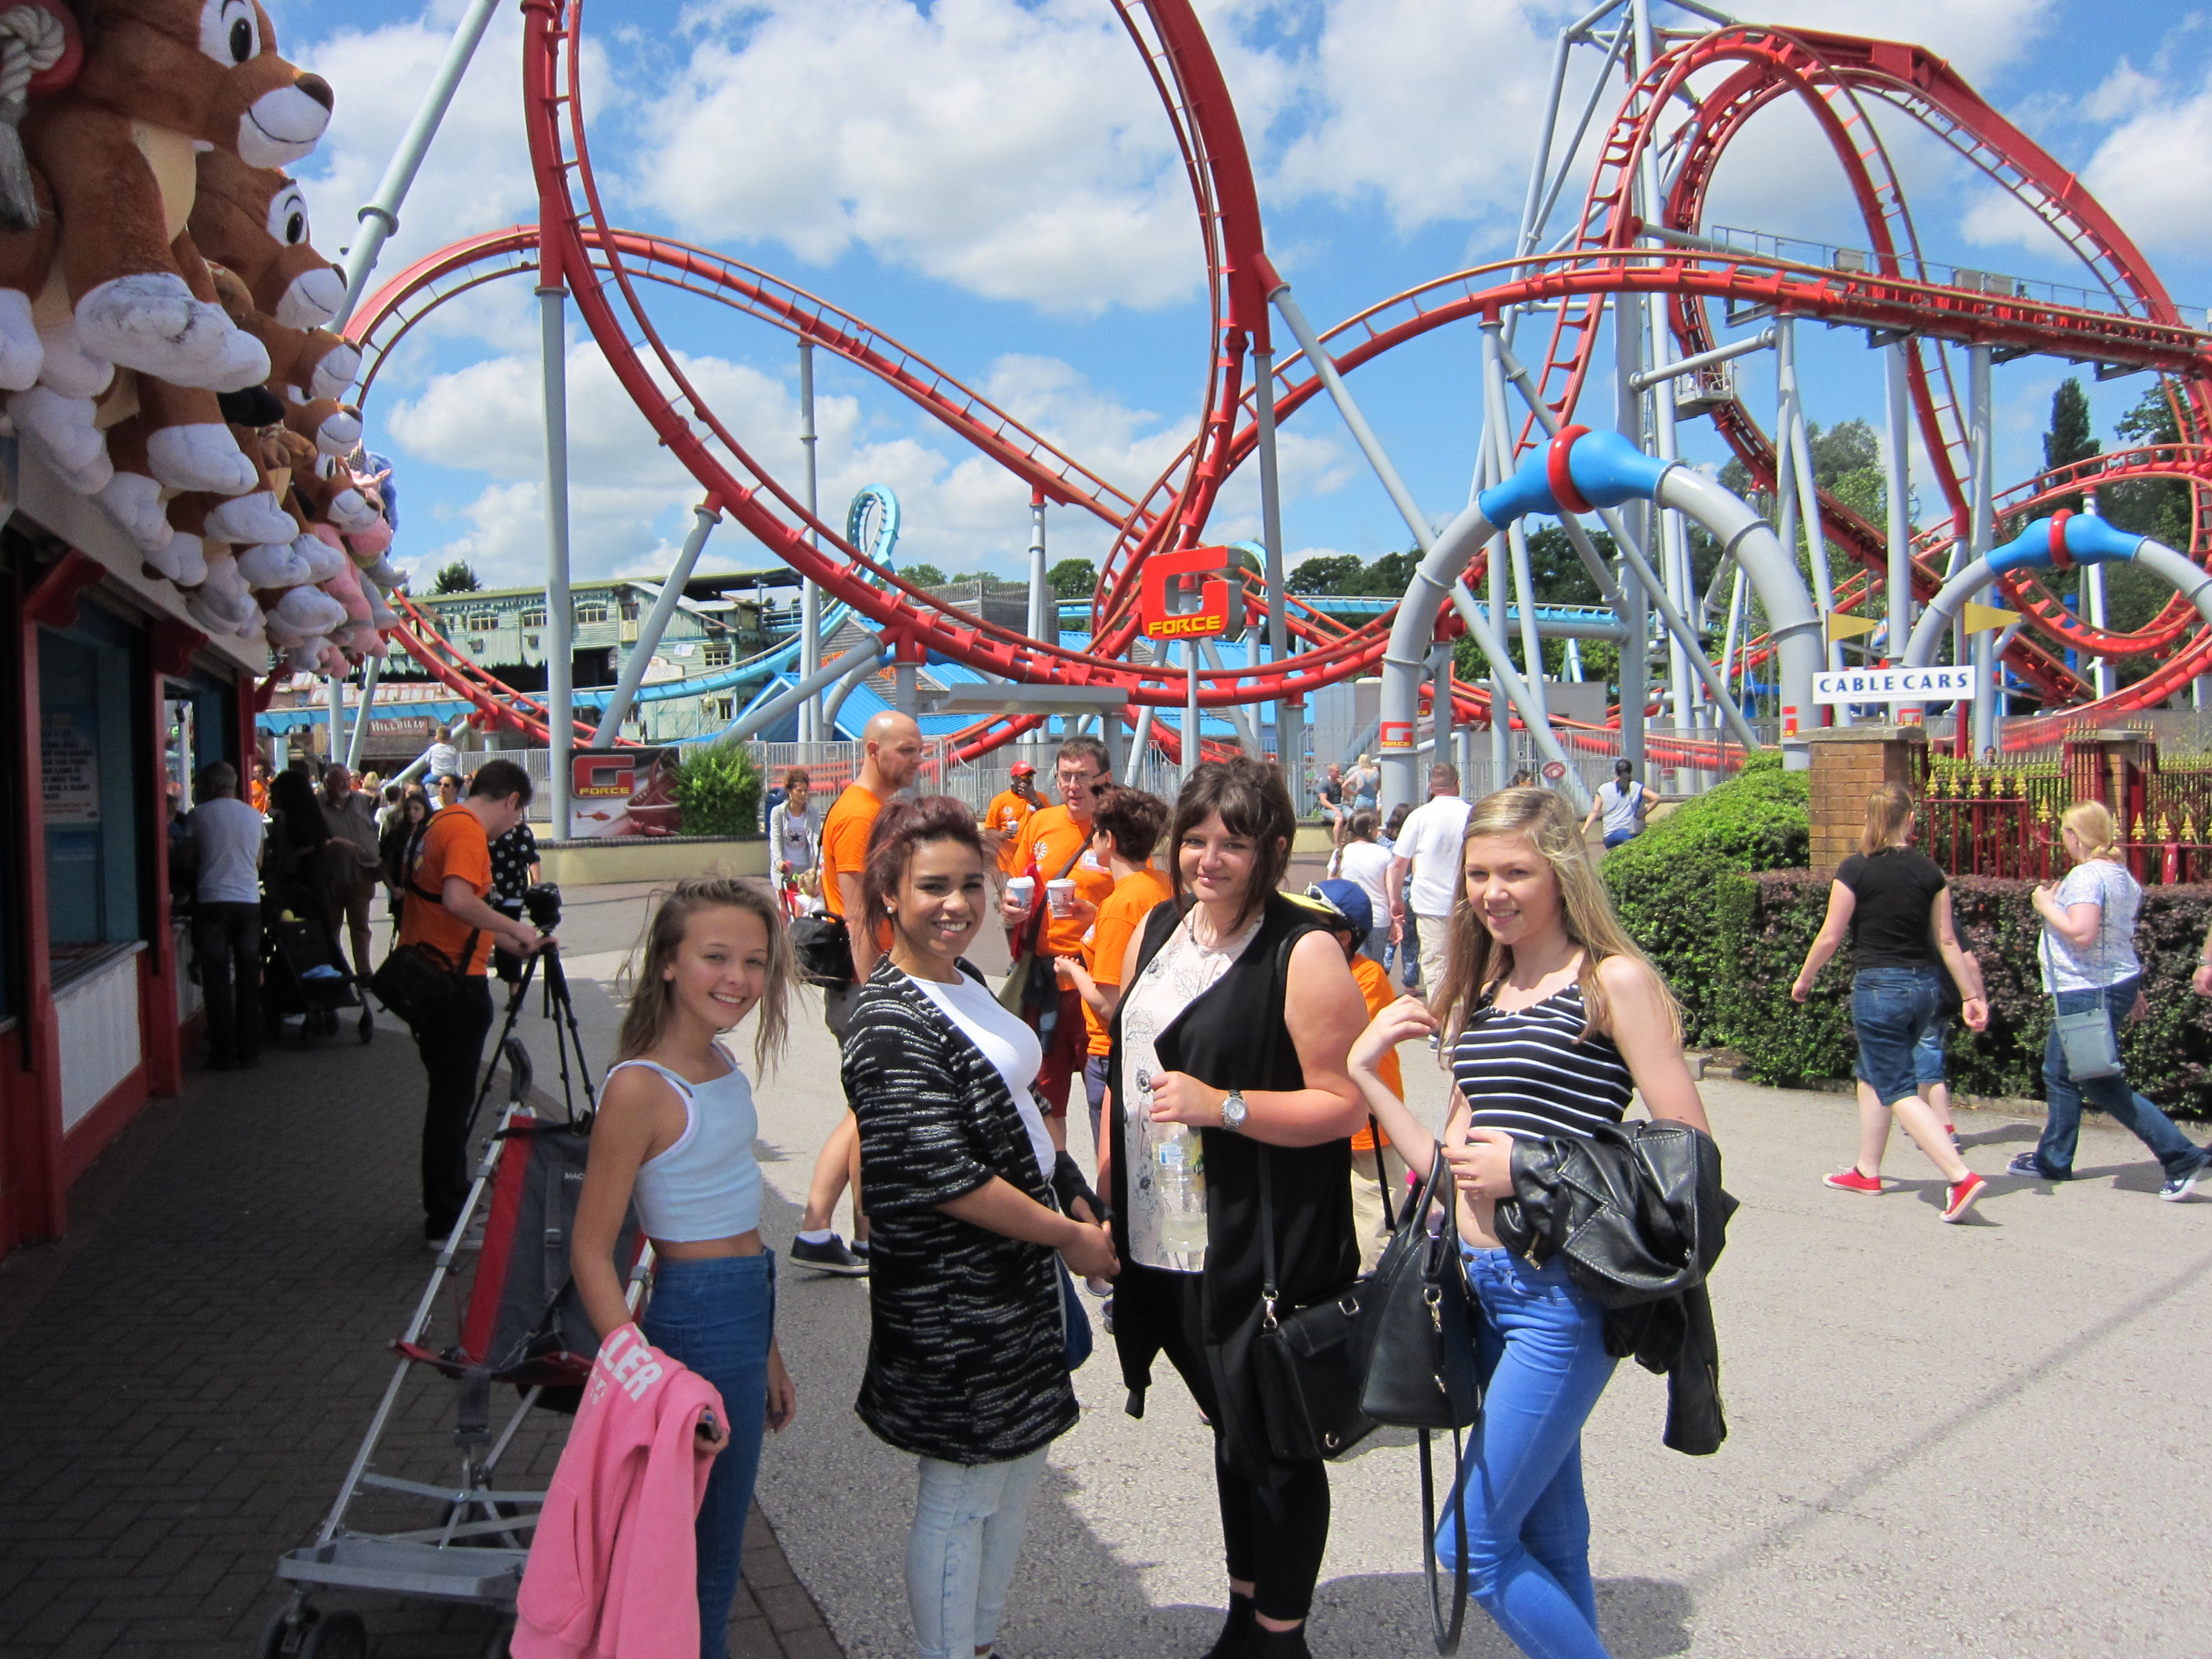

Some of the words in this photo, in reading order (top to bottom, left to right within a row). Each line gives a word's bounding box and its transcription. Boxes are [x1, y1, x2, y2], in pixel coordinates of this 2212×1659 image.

[1148, 615, 1221, 636] FORCE
[1819, 675, 1894, 693] CABLE
[1903, 672, 1967, 689] CARS
[370, 720, 426, 732] HILLBILLY
